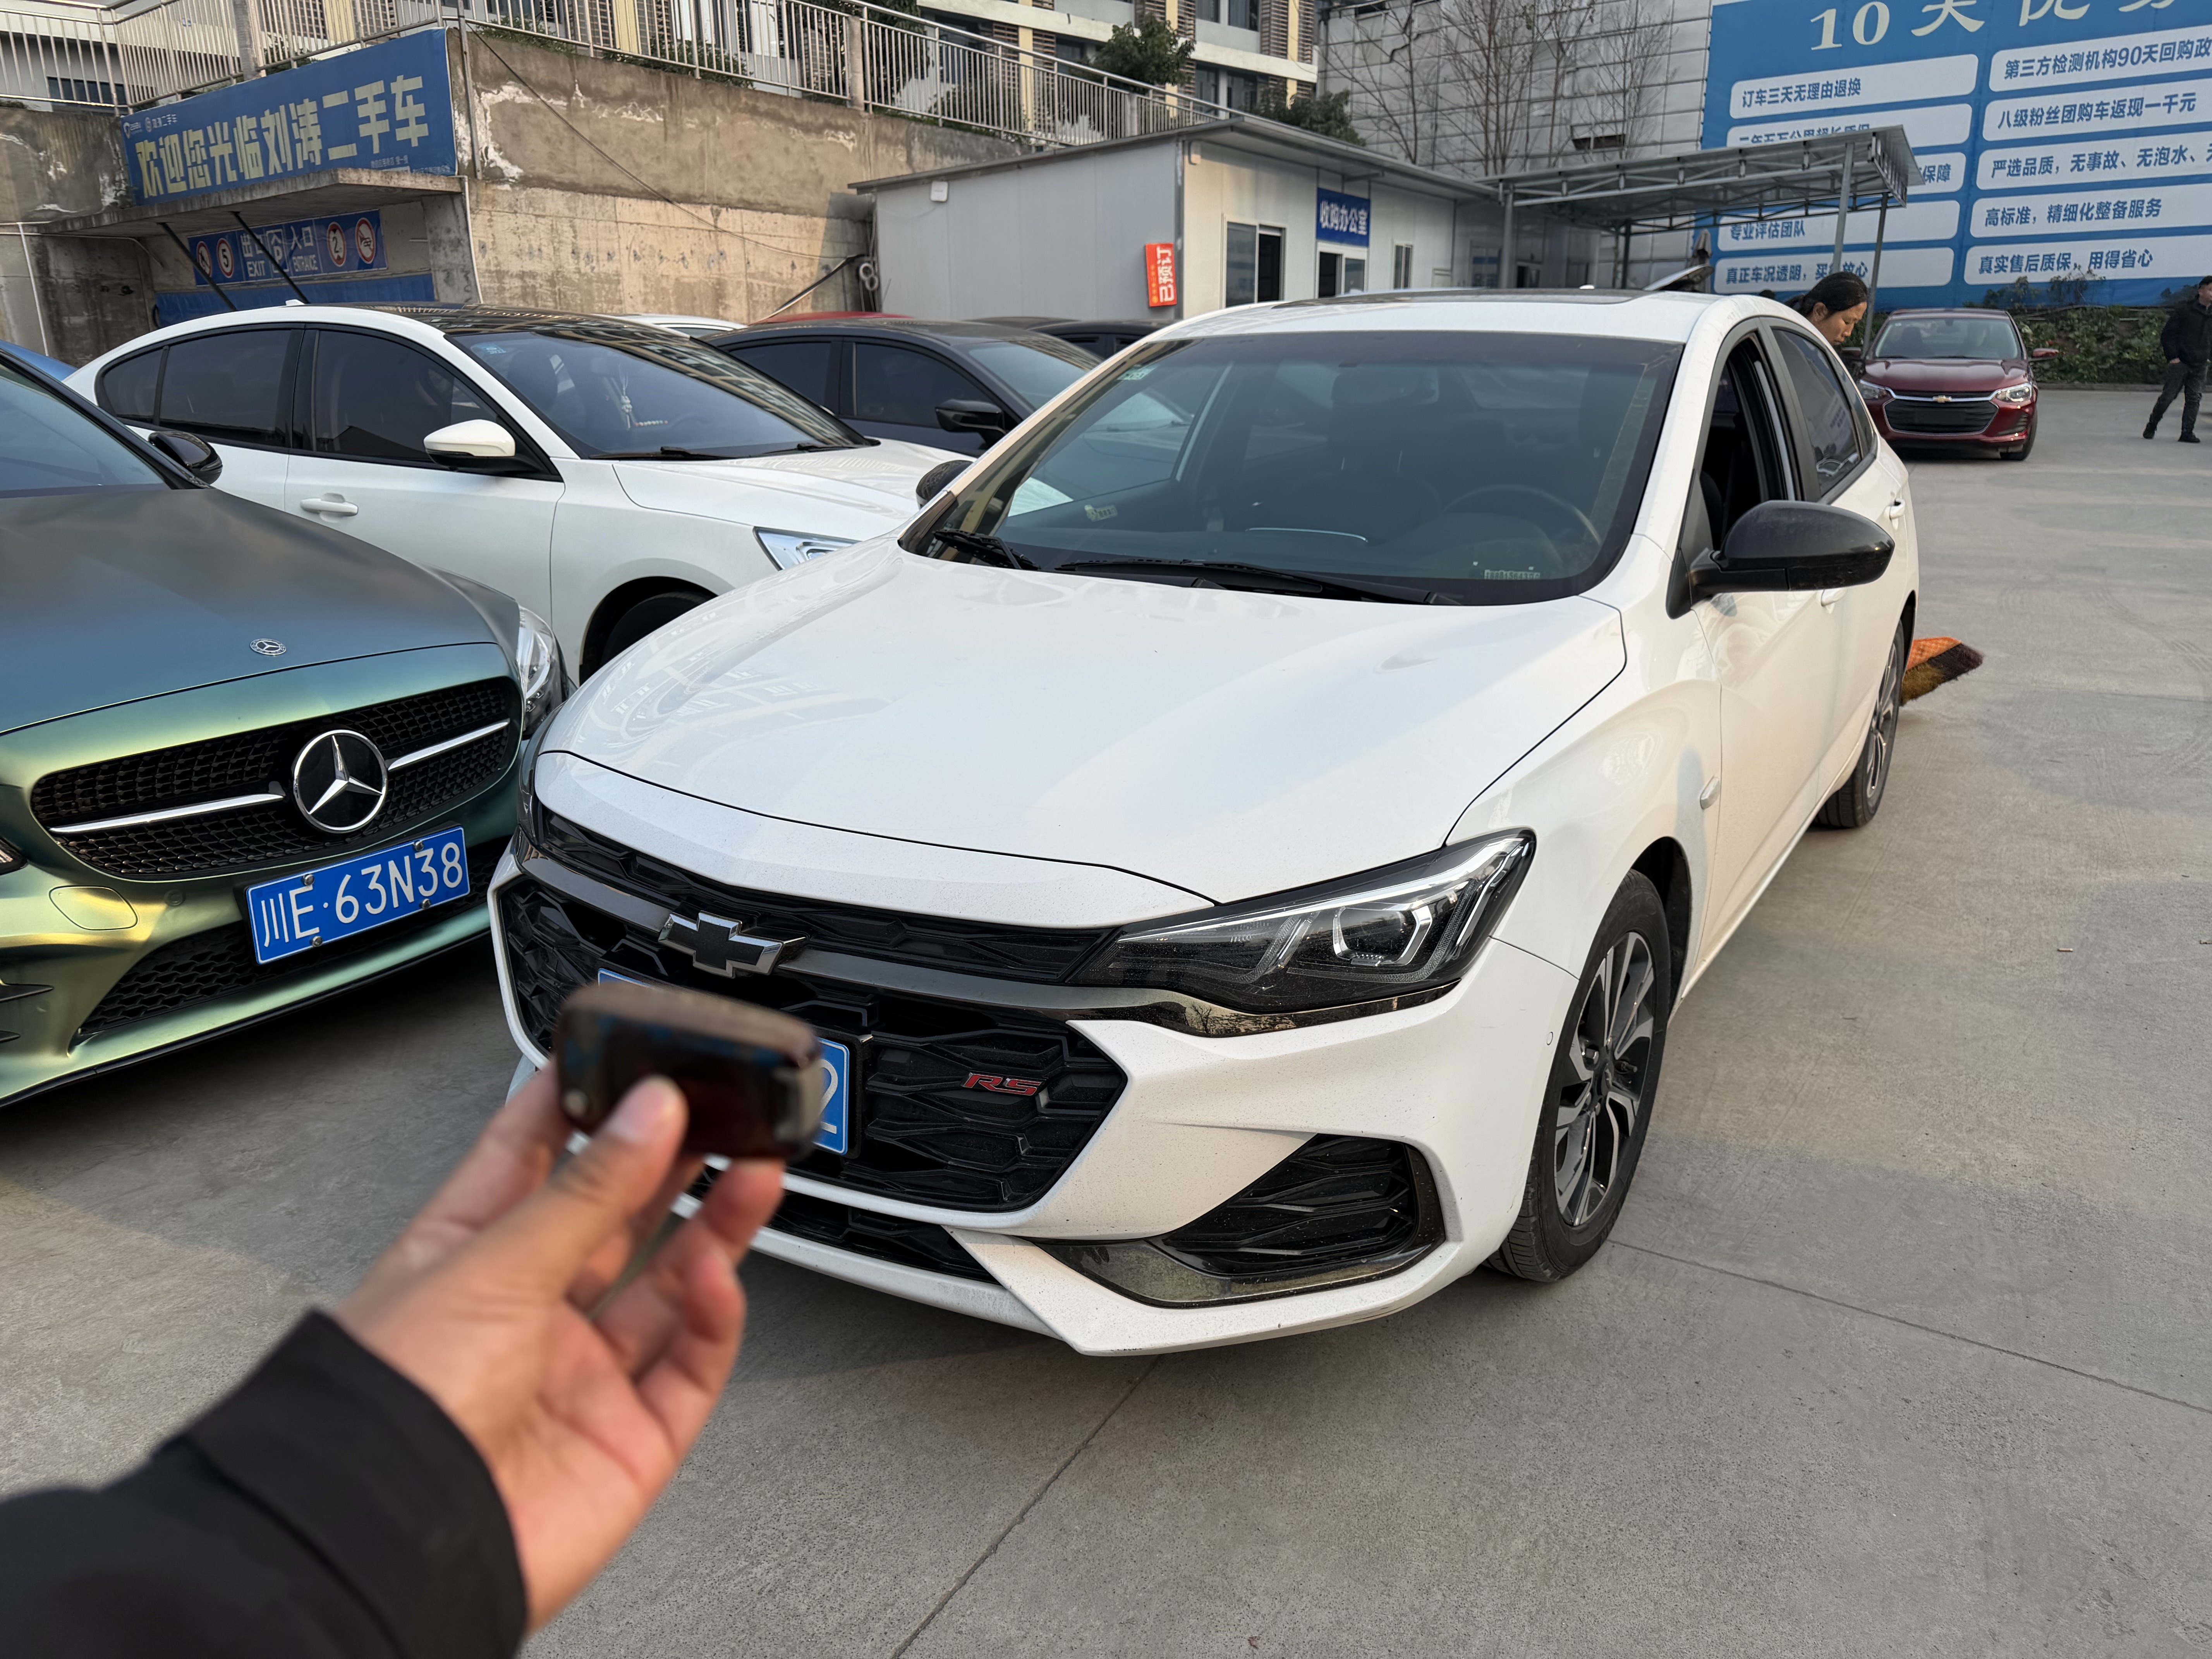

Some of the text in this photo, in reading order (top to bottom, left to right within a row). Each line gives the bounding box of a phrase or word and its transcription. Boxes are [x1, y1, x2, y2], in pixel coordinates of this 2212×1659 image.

[1742, 78, 1862, 108] 订车三天无理由退换
[1997, 92, 2197, 129] 八级粉丝团购车返现一千元
[135, 75, 429, 199] 欢迎您光临刘涛二手车
[1320, 200, 1368, 235] 收购办公室
[1730, 220, 1805, 241] 专业评估团队
[290, 225, 314, 250] 入口
[222, 248, 229, 268] 5
[246, 260, 265, 277] EXIT
[1156, 246, 1175, 303] 已预订
[1726, 261, 1869, 285] 真正车况透明，买放心
[261, 842, 463, 947] 川E·63N38
[963, 1072, 1042, 1096] RS
